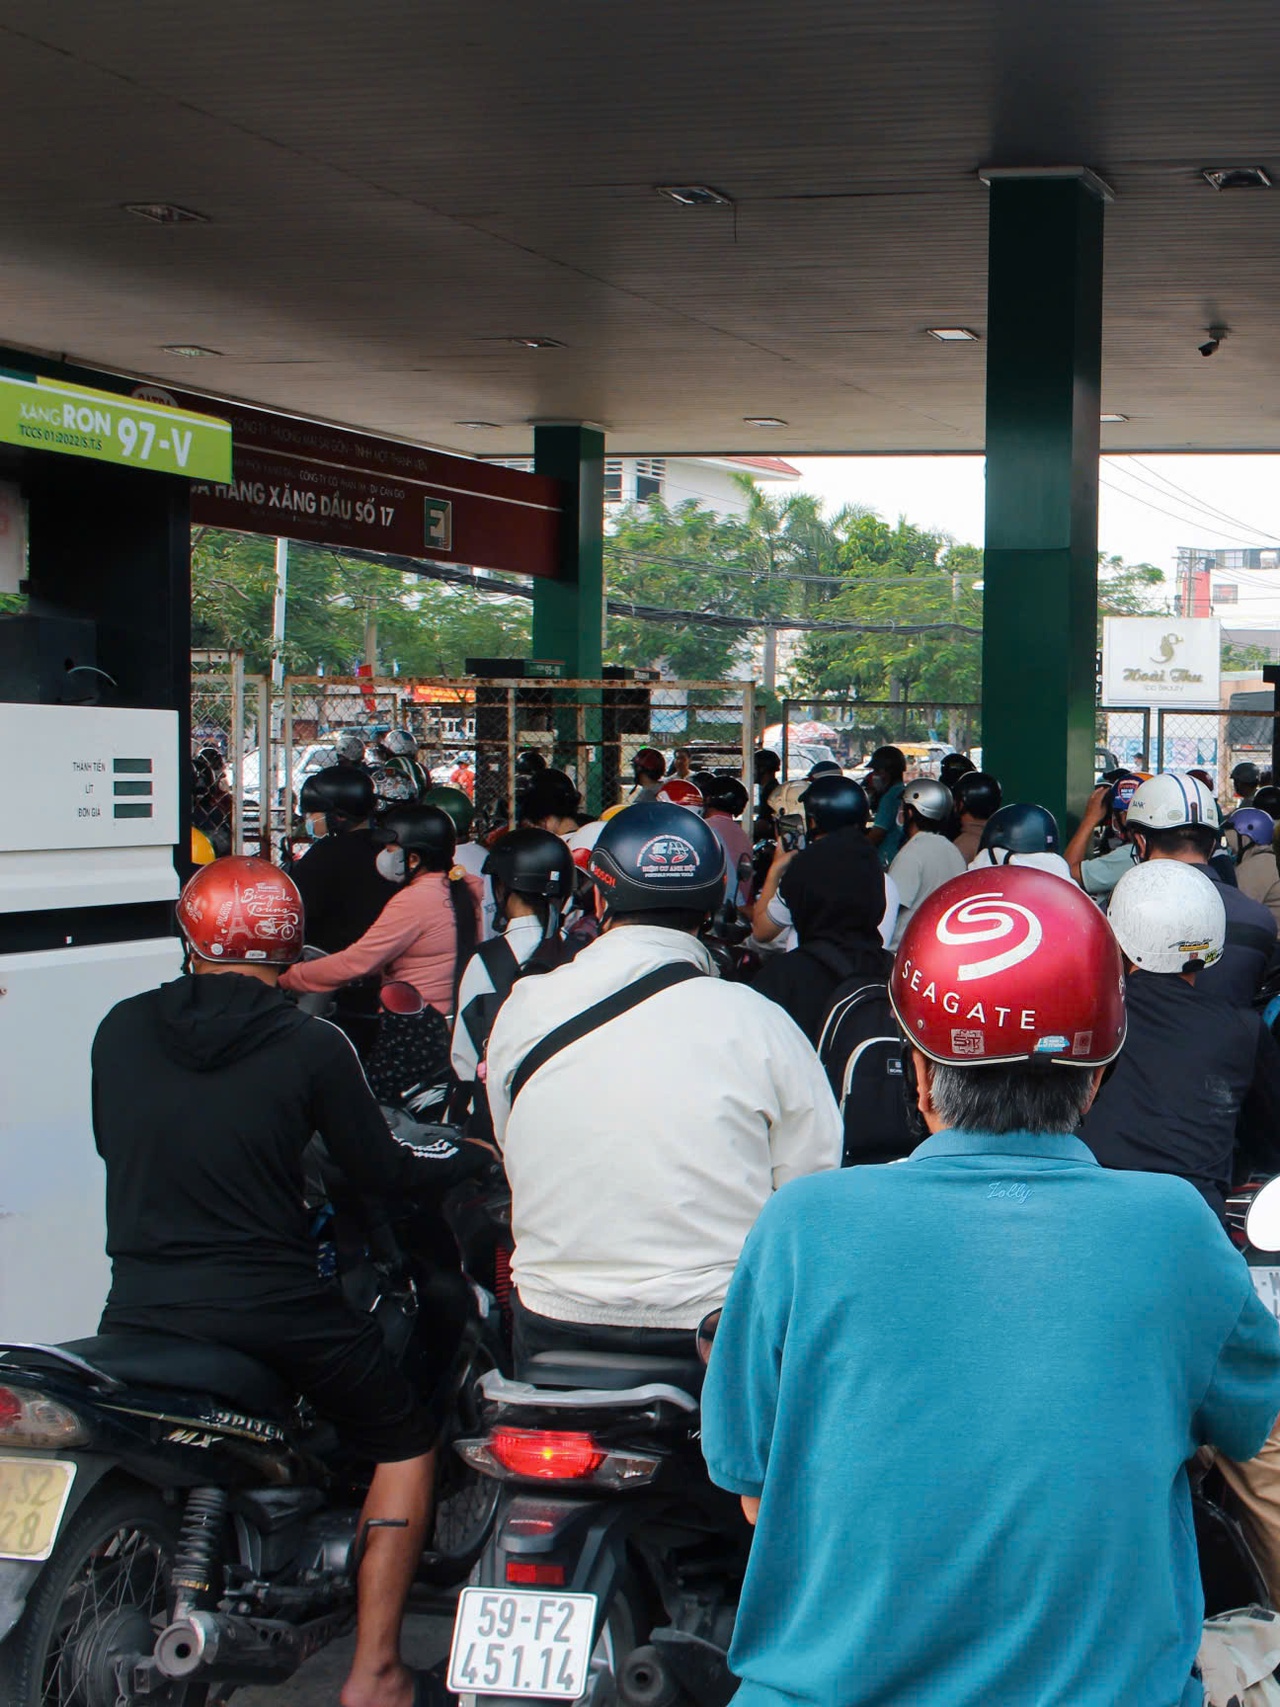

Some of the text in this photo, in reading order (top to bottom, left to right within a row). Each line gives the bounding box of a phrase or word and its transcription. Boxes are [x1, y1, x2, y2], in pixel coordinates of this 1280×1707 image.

[20, 424, 43, 440] TCCS
[62, 403, 112, 437] RON
[117, 417, 193, 467] 97-V
[268, 482, 317, 514] XĂNG
[320, 490, 352, 520] DẦU
[355, 497, 377, 524] SỐ
[380, 506, 395, 527] 17
[1123, 668, 1204, 683] Hoài Thu
[241, 888, 293, 908] Bicycle
[902, 959, 1036, 1030] SEAGATE
[477, 1596, 575, 1643] 59-F2
[461, 1643, 574, 1690] 451.14
